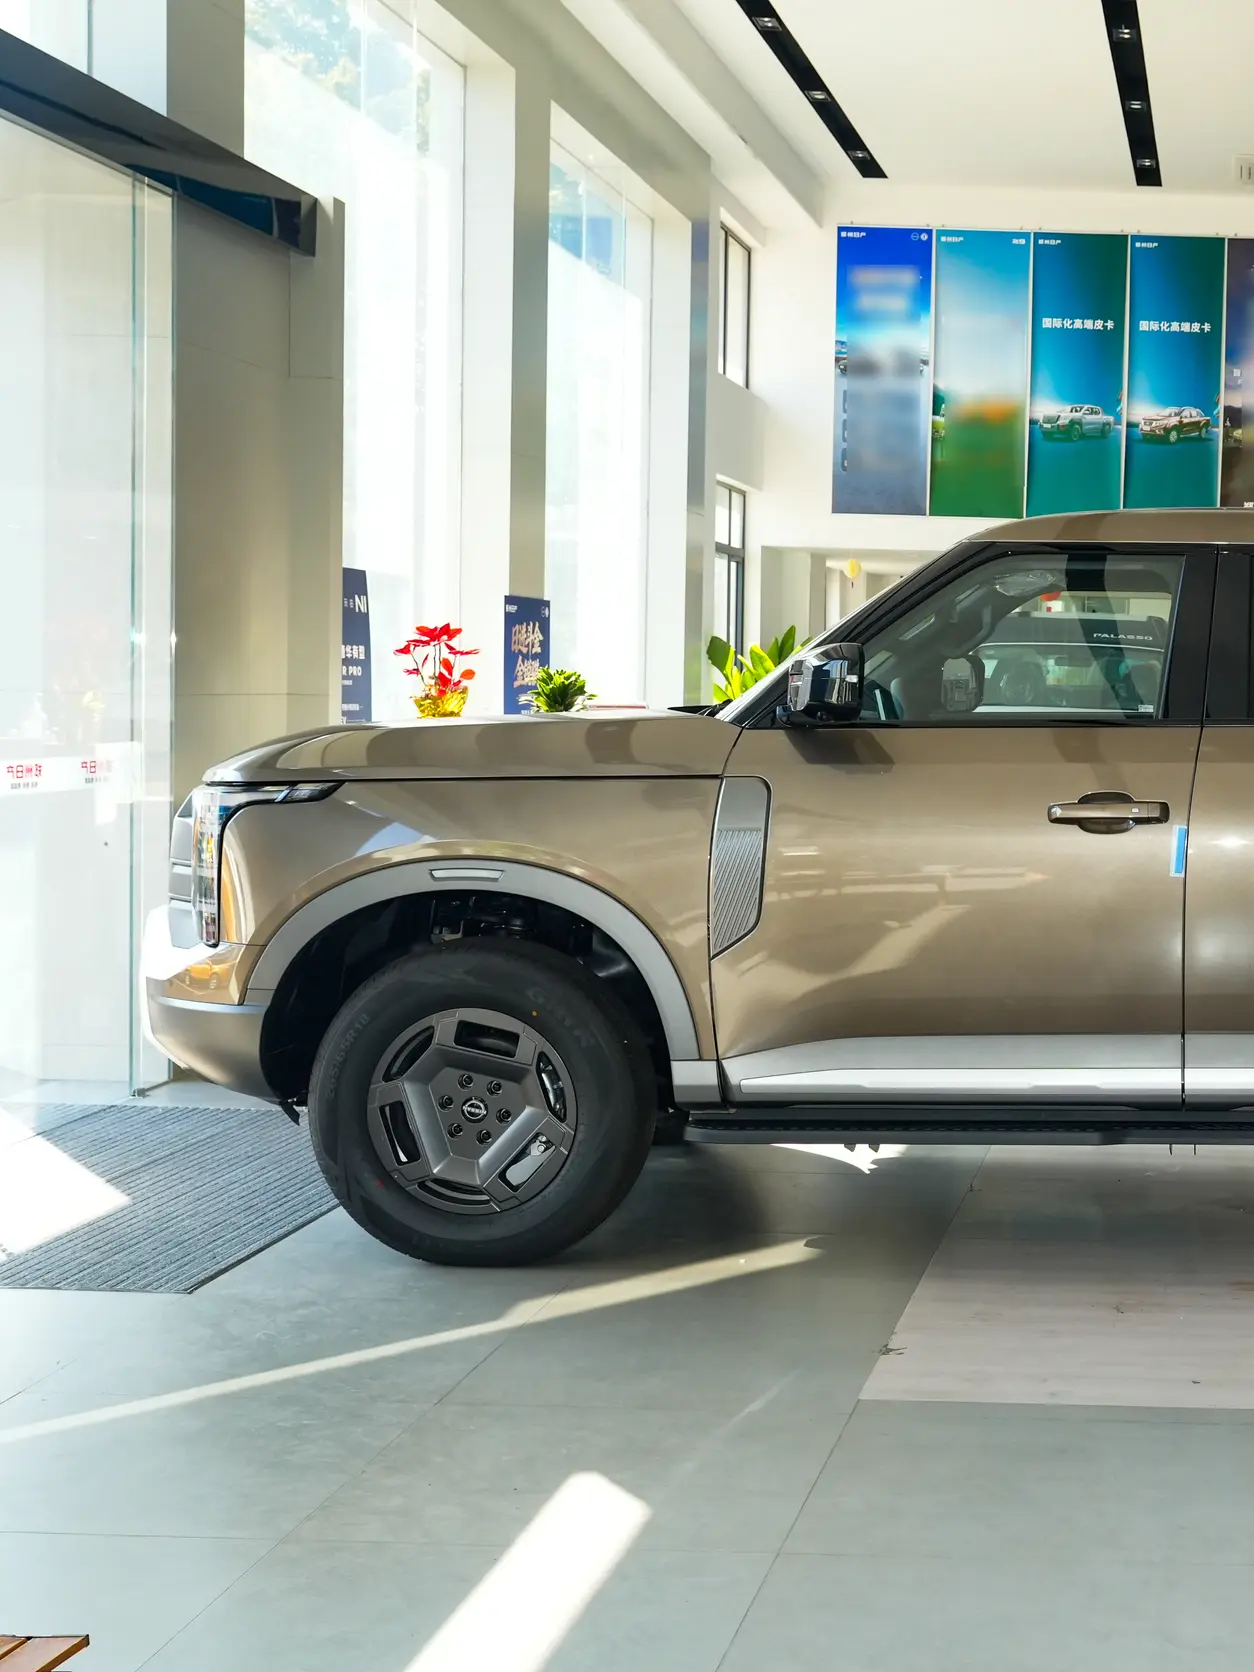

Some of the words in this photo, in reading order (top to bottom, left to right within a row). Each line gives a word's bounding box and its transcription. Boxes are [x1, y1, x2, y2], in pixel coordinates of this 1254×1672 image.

[1042, 317, 1115, 331] 国际化高端皮卡
[1139, 320, 1211, 334] 国际化高端皮卡
[349, 665, 363, 677] PRO
